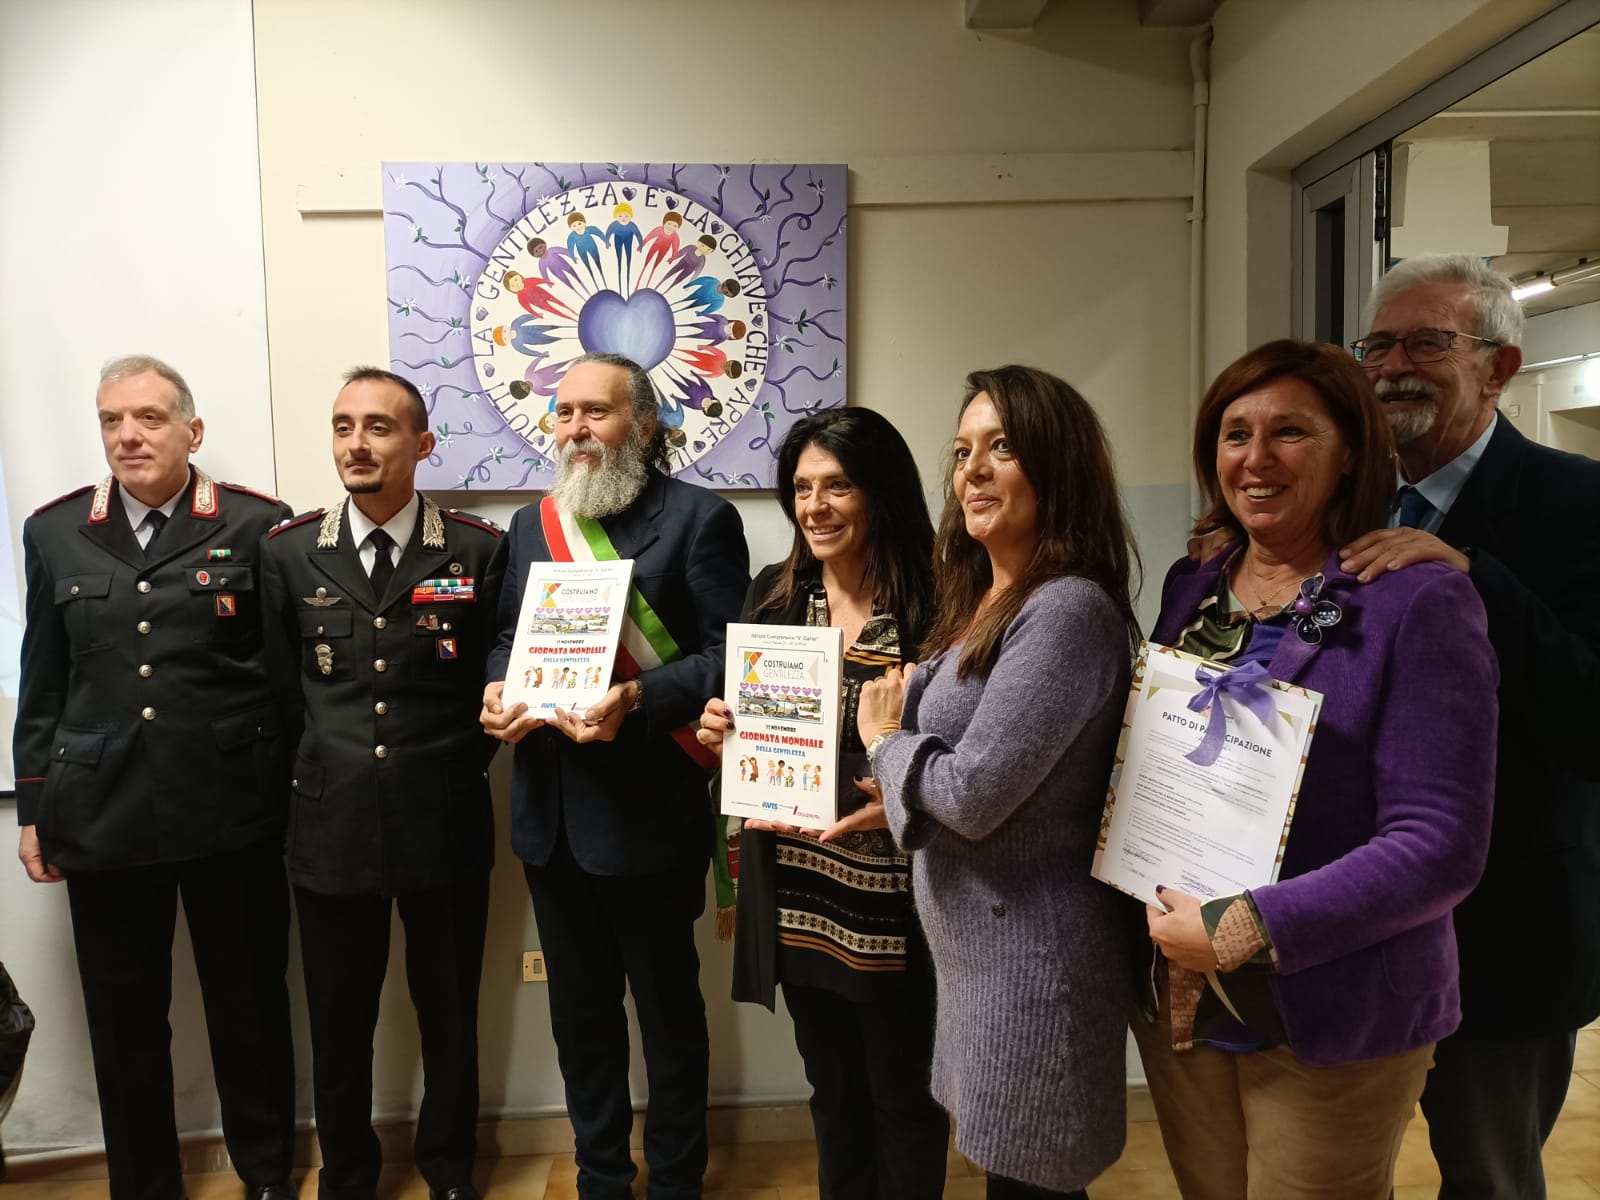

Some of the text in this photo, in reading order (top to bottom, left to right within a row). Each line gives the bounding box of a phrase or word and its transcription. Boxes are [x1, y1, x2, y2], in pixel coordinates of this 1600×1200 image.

[682, 200, 709, 233] LA
[476, 182, 619, 300] GENTILEZZA
[719, 233, 767, 314] CHIAVE
[473, 327, 494, 356] LA
[744, 330, 768, 375] CHE
[484, 382, 538, 445] TUTTI
[700, 387, 751, 447] APRE
[528, 646, 607, 654] GIORNATA MONDIALE
[763, 660, 803, 670] COSTRUIAMO
[764, 669, 805, 680] GENTILEZZA
[740, 731, 824, 749] GIORNATA MONDIALE
[1162, 711, 1188, 727] PATTO
[1188, 722, 1198, 732] DI
[1200, 725, 1273, 758] PCIPAZIONE
[773, 747, 806, 757] GENTILEZZA
